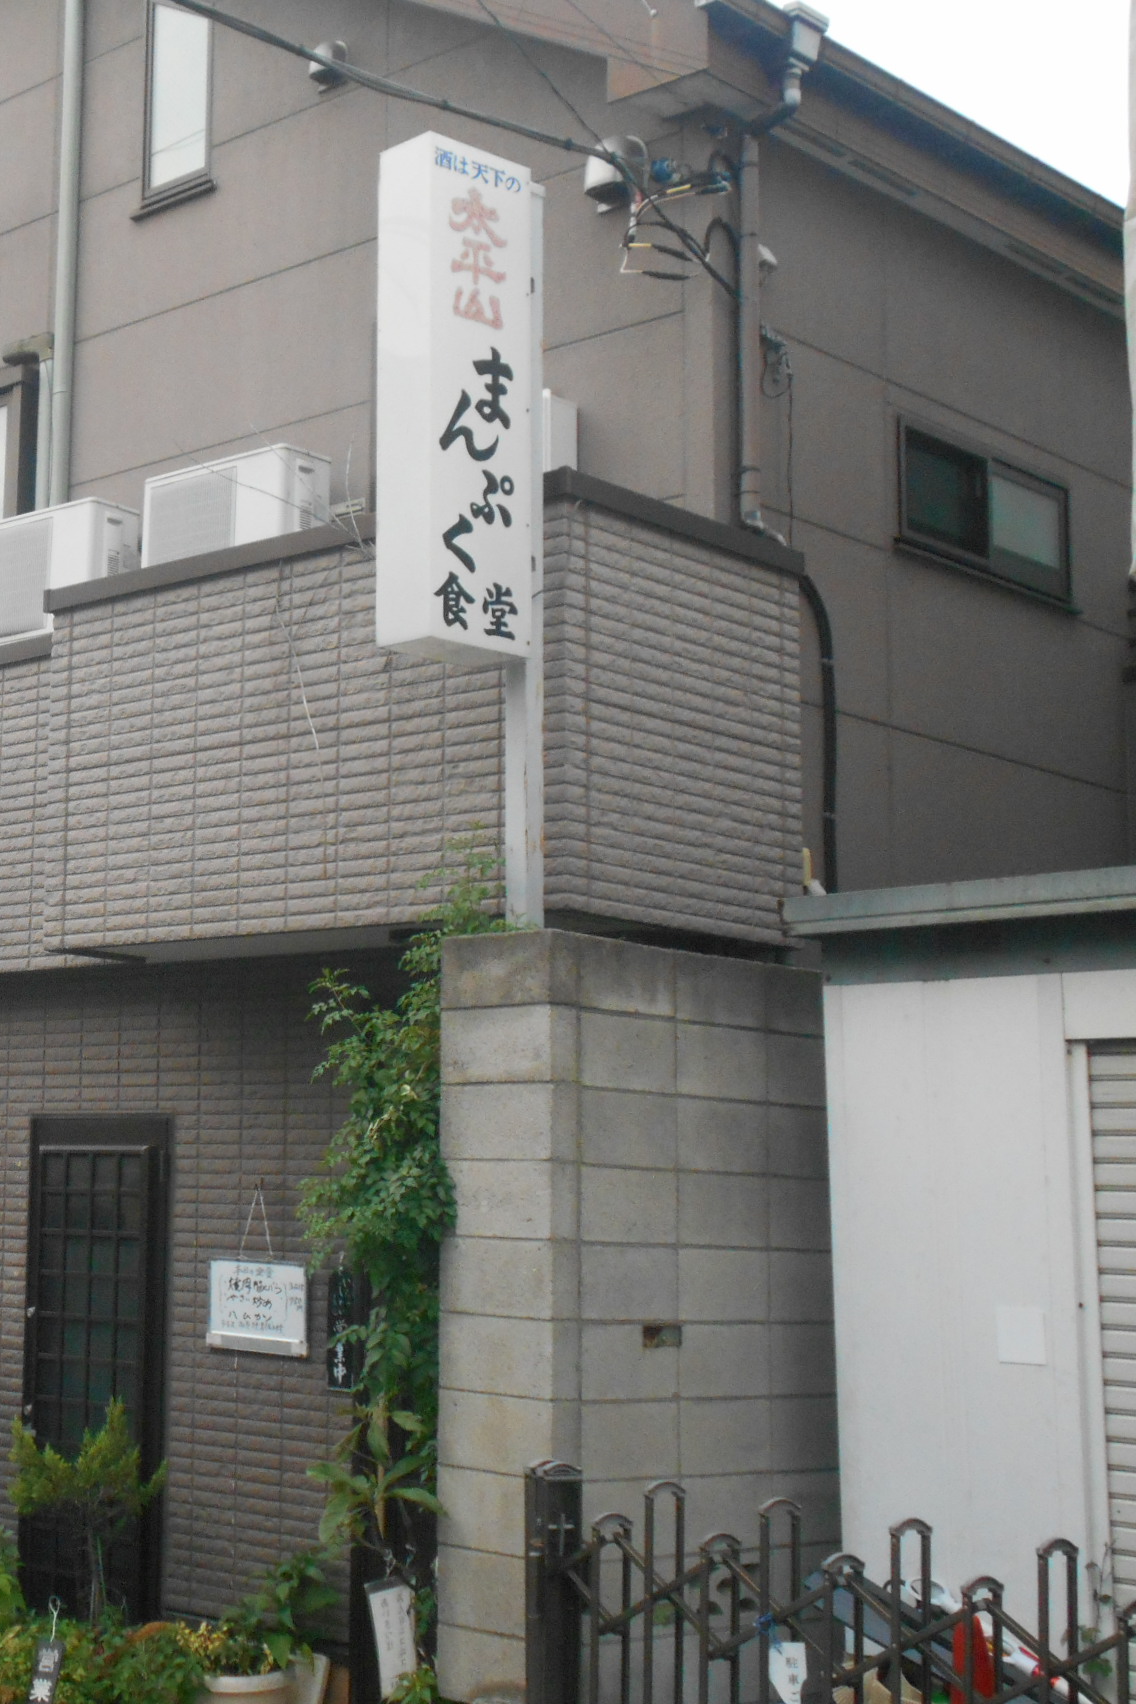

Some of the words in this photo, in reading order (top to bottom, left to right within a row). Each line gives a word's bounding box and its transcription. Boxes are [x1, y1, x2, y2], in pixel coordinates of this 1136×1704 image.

[435, 146, 522, 193] 酒は天下の
[438, 346, 516, 573] まんぷく
[433, 570, 519, 641] 食堂
